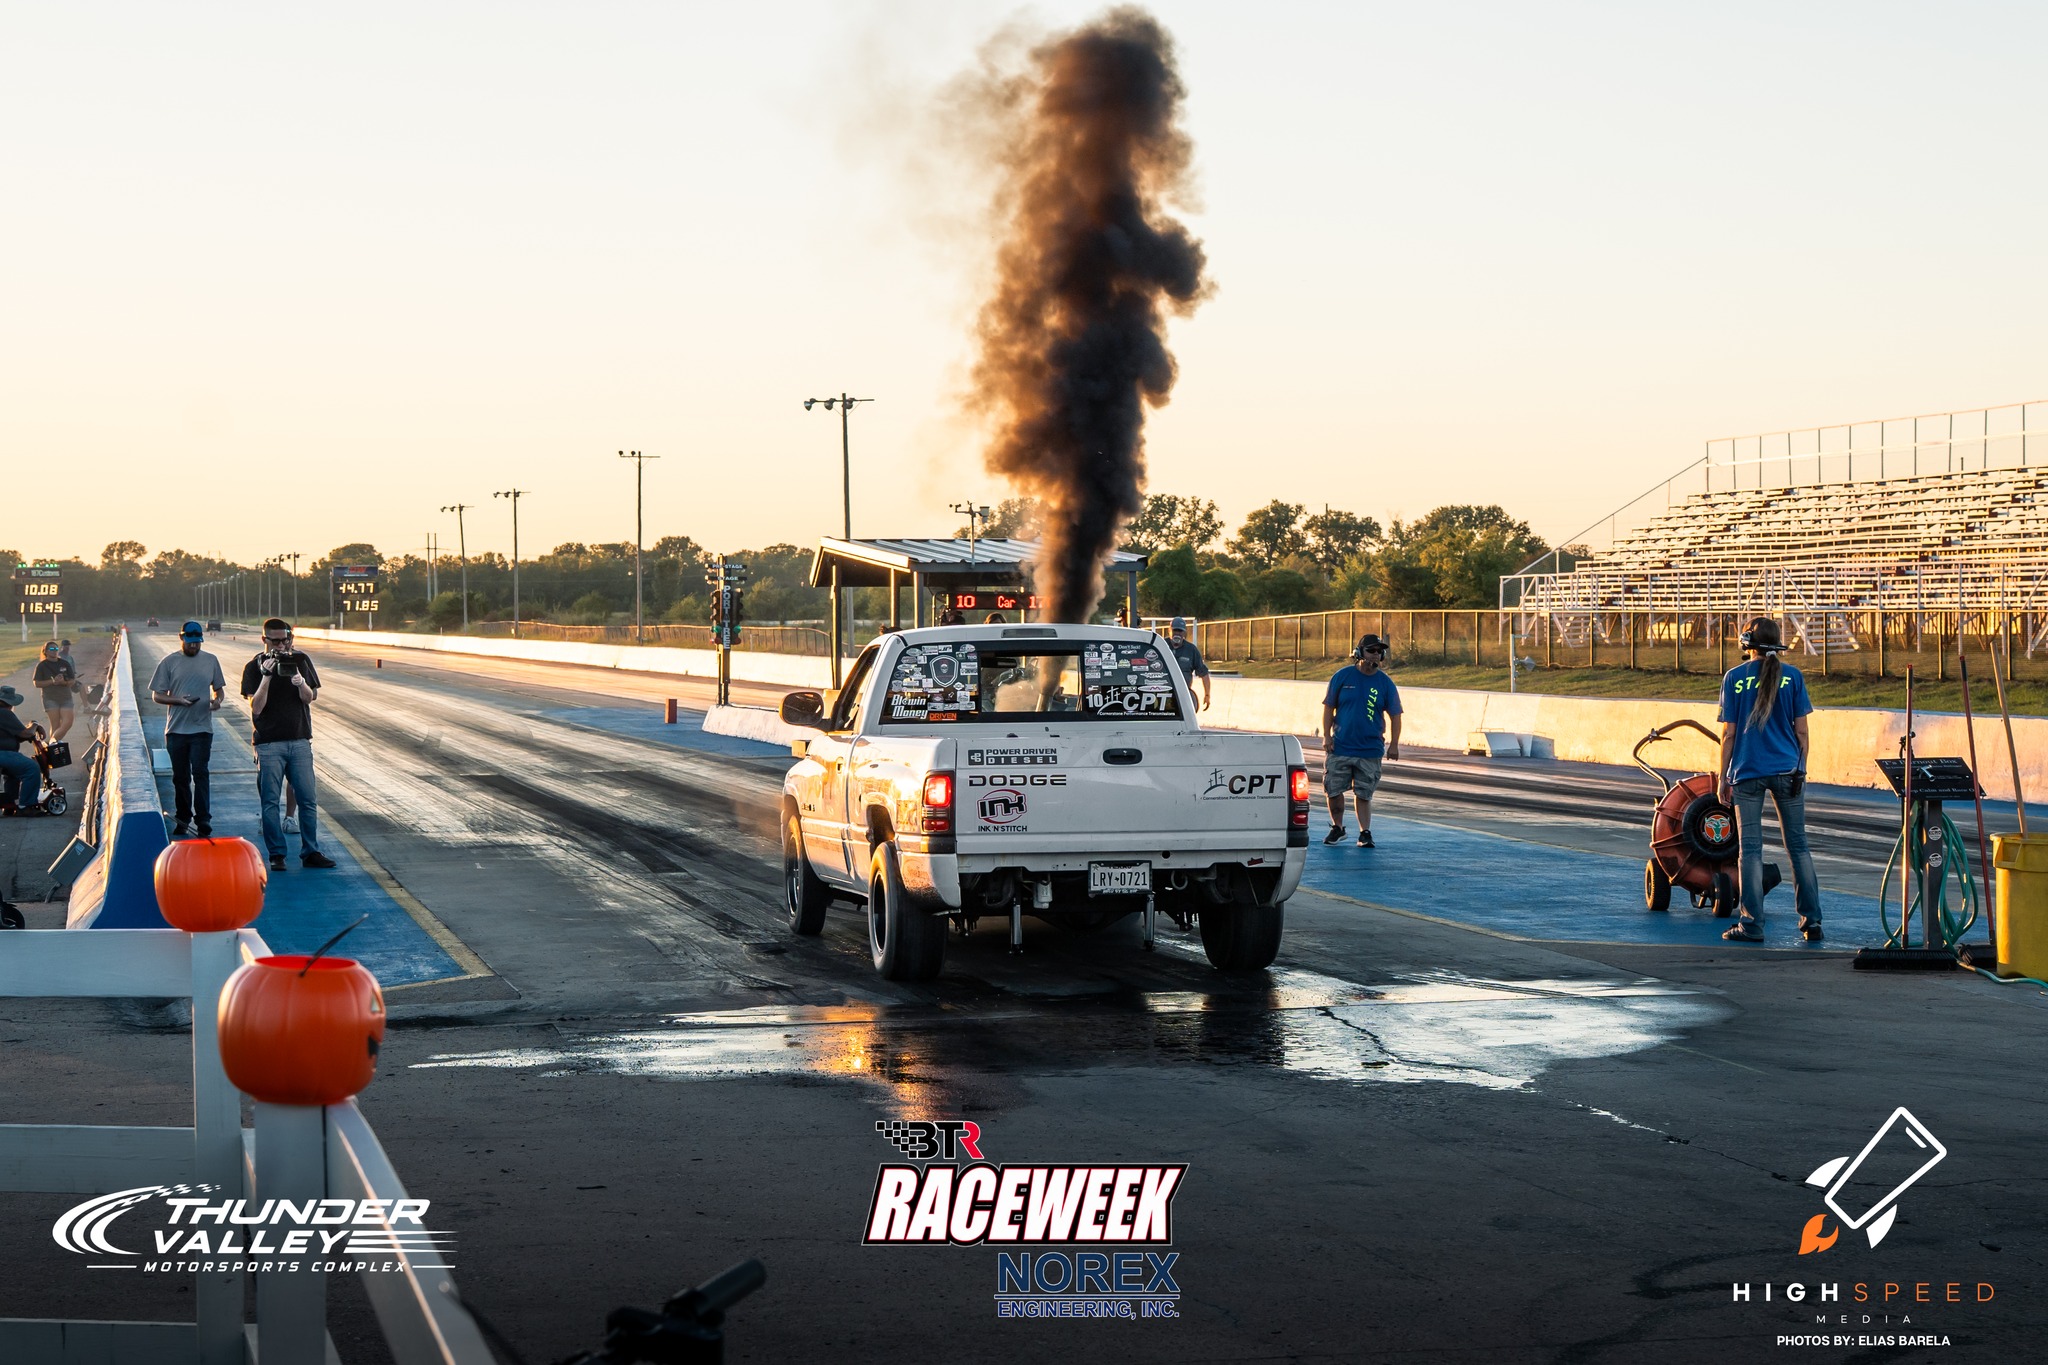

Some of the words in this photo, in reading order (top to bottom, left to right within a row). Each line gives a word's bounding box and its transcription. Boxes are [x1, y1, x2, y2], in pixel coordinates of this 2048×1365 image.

[25, 584, 58, 595] 10.08
[956, 595, 976, 608] 10
[997, 595, 1016, 608] Car
[1735, 676, 1791, 694] STF
[1086, 693, 1104, 708] 10
[1122, 692, 1173, 711] CPT
[1367, 687, 1379, 723] STAFF
[892, 705, 928, 719] Money
[929, 712, 957, 720] DRIVEN
[1022, 747, 1057, 755] DRIVEN
[987, 756, 1057, 764] DIESEL
[969, 774, 1067, 787] DODGE
[1228, 774, 1282, 795] CPT
[1093, 872, 1113, 886] LRY
[1120, 871, 1147, 886] 0721
